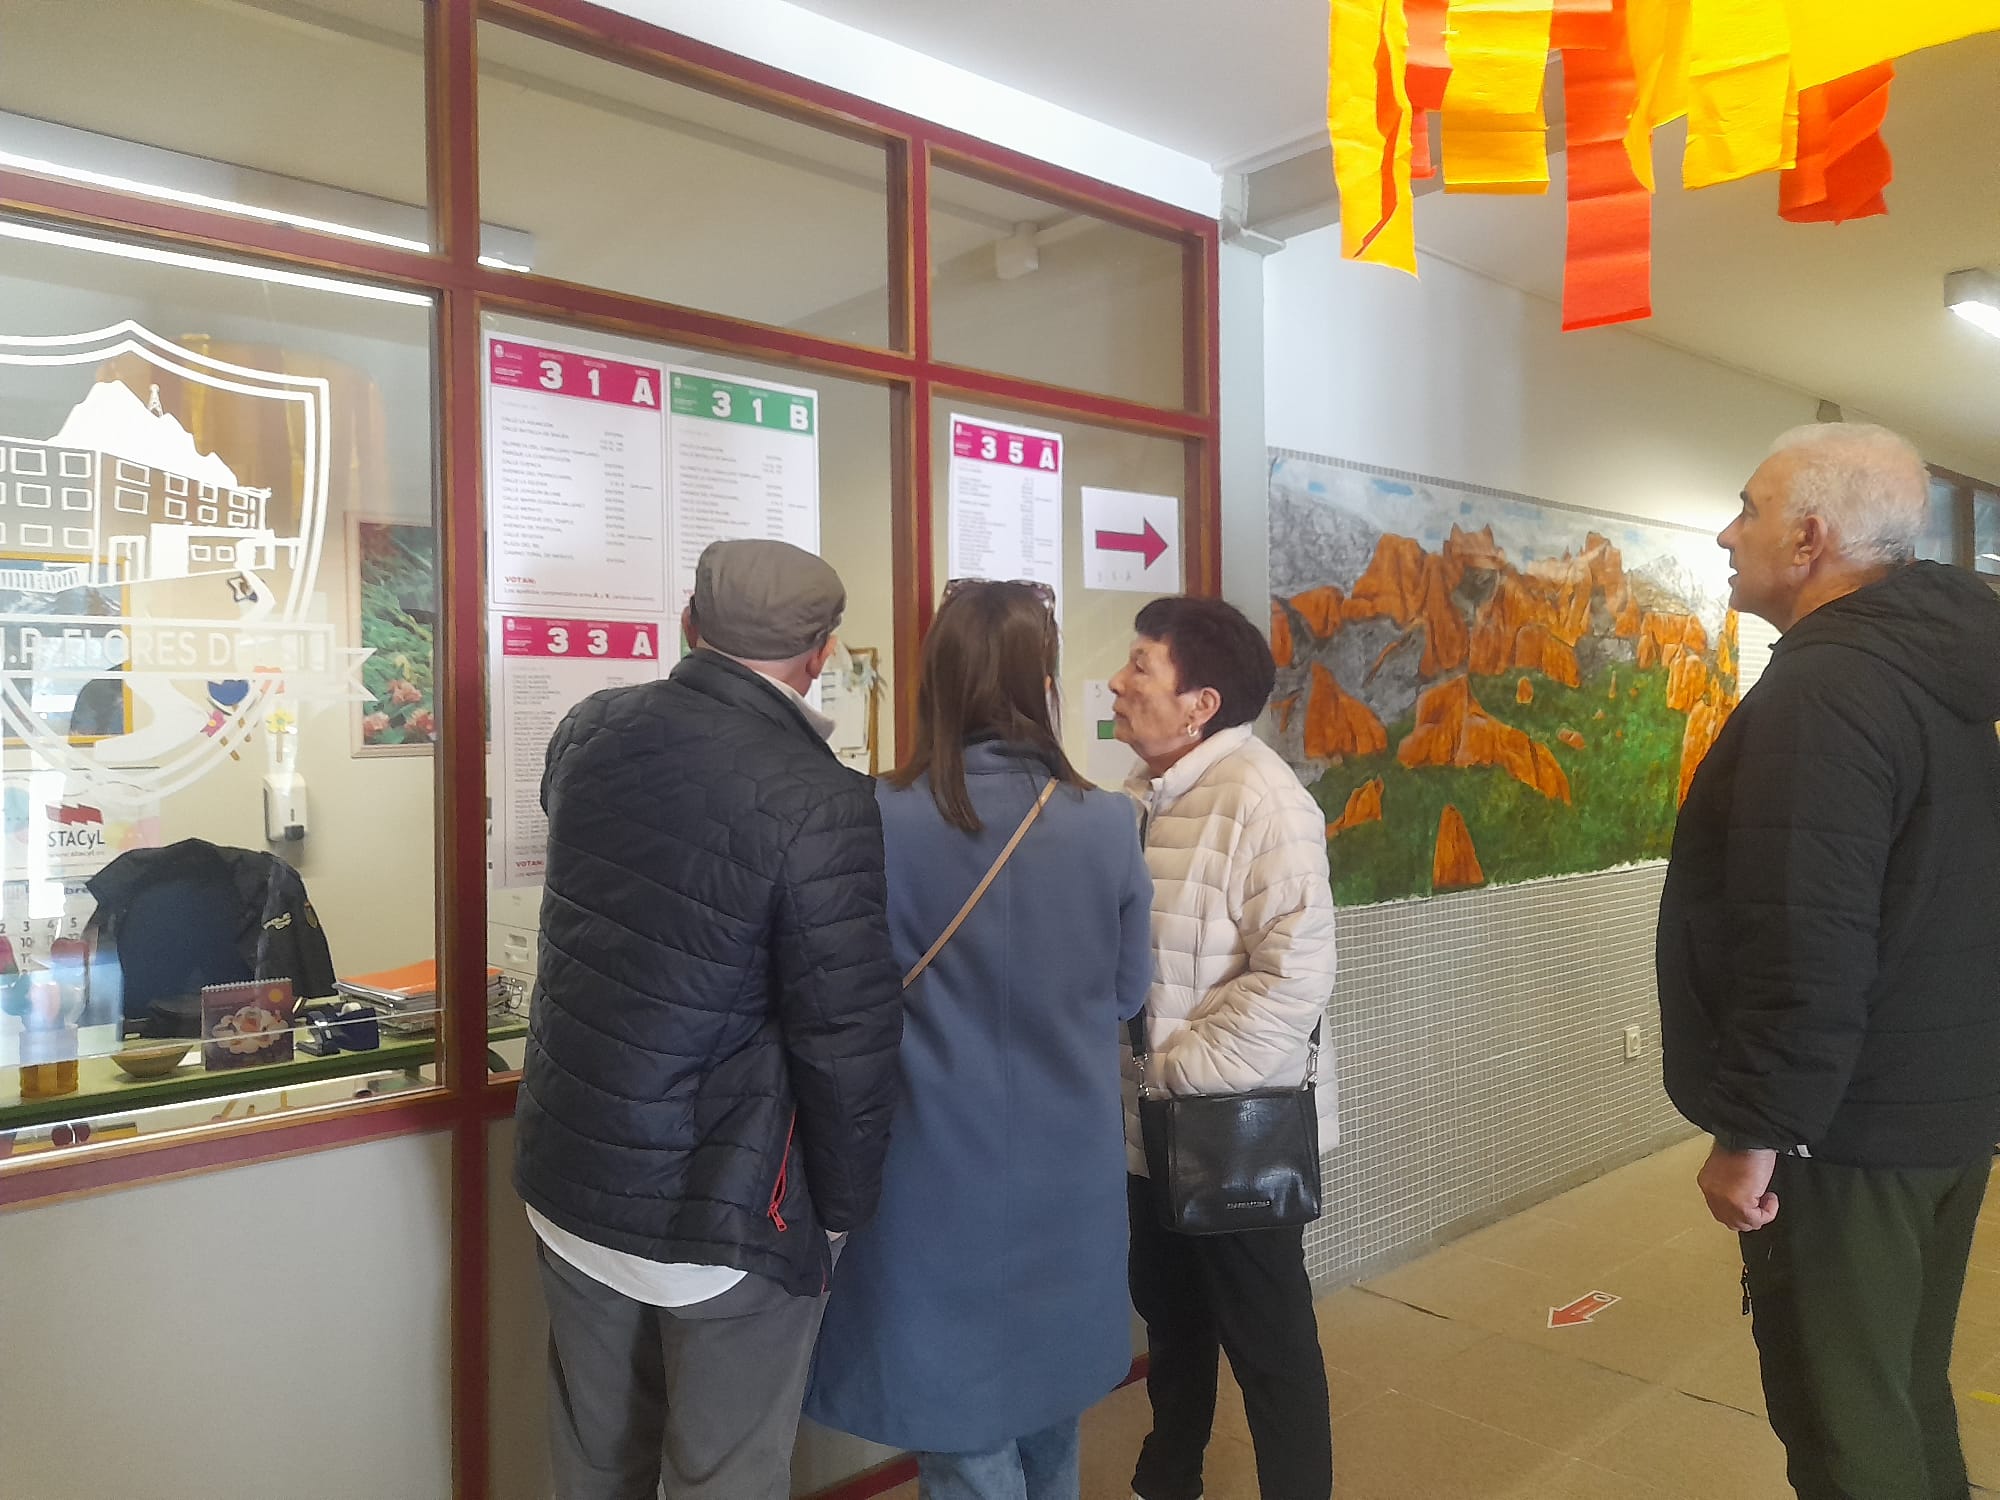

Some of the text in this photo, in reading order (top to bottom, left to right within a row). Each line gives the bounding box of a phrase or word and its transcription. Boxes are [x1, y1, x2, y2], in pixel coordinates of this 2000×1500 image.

[538, 360, 563, 390] 3
[587, 369, 600, 396] 1
[632, 377, 655, 406] A
[711, 390, 732, 418] 3
[752, 398, 763, 423] 1
[789, 404, 809, 430] B
[981, 435, 997, 460] 3
[1008, 441, 1024, 464] 5
[1039, 446, 1056, 470] A
[547, 627, 569, 654] 3
[587, 629, 608, 655] 3
[632, 631, 653, 657] A
[47, 829, 105, 849] STACyL
[23, 921, 30, 932] 3
[70, 917, 77, 928] 5
